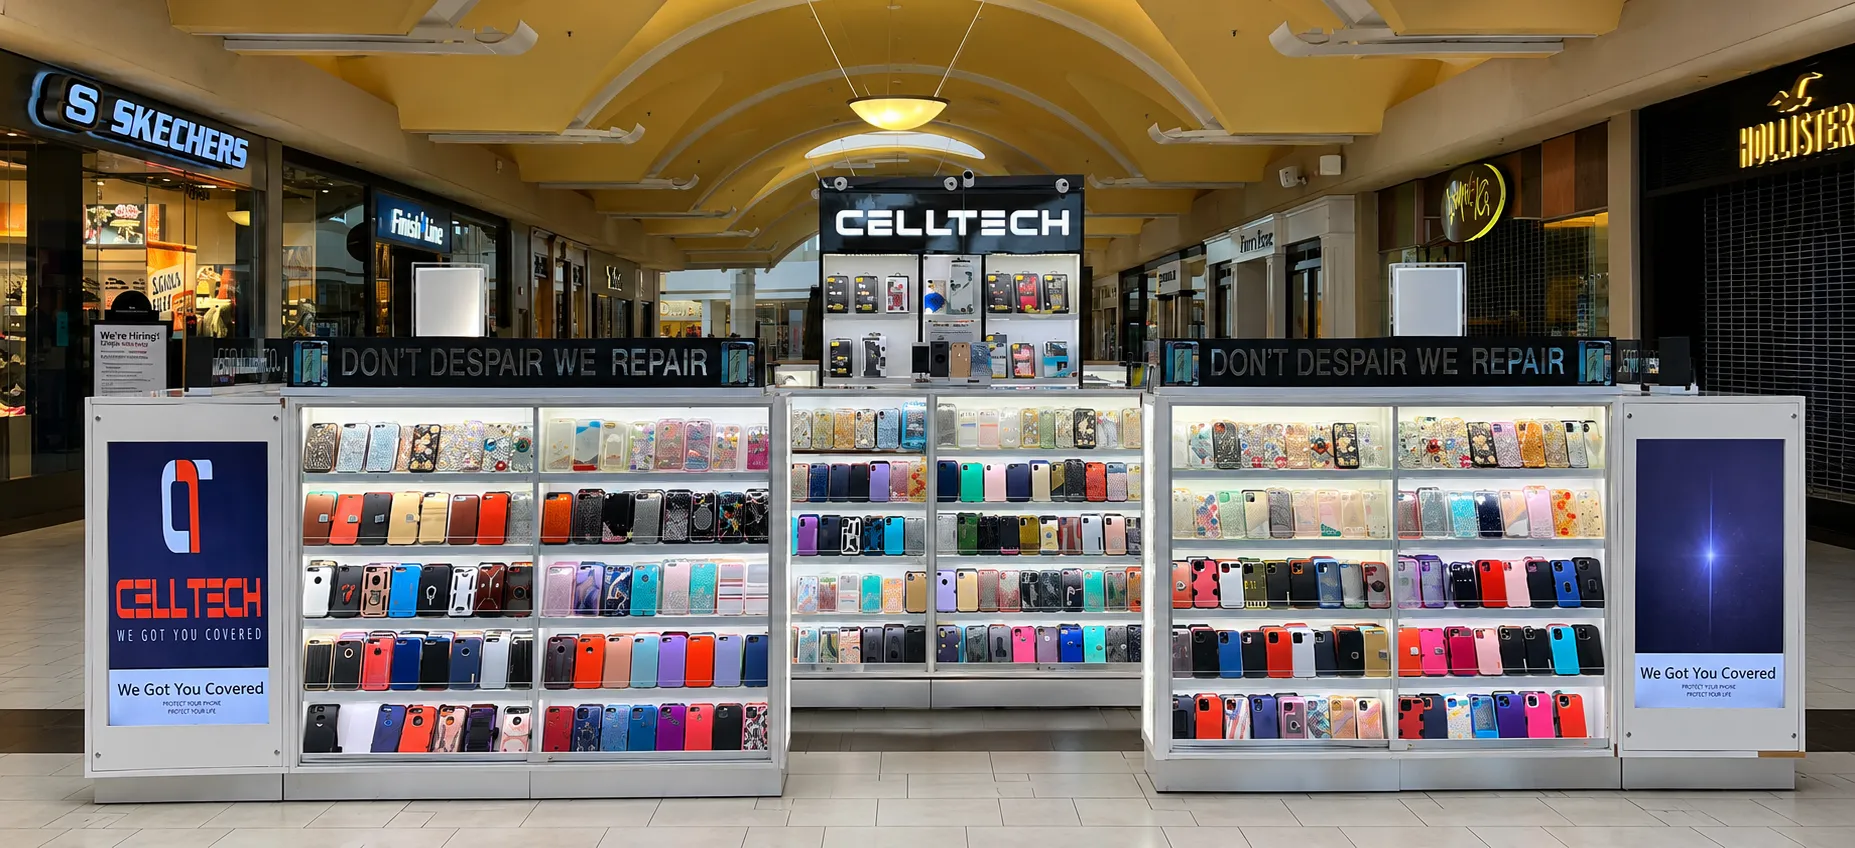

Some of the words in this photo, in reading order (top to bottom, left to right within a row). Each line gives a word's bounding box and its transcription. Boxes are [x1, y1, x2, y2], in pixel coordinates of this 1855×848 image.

[110, 98, 249, 170] SKECHERS
[1739, 102, 1855, 168] HOLLISTER
[391, 208, 421, 240] Finish
[424, 216, 444, 246] Line
[835, 209, 1070, 236] CELLTECH
[341, 347, 422, 377] DON'T
[430, 347, 543, 377] DESPAIR
[553, 347, 596, 377] WE
[611, 347, 708, 377] REPAIR
[1210, 347, 1289, 376] DON'T
[1298, 347, 1408, 376] DESPAIR
[1416, 347, 1459, 376] WE
[1472, 347, 1565, 376] REPAIR
[115, 577, 262, 619] CELLTECH
[116, 628, 133, 642] WE
[141, 628, 165, 642] GOT
[173, 628, 198, 641] YOU
[205, 627, 262, 641] COVERED
[1640, 666, 1661, 680] We
[1665, 666, 1689, 680] Got
[1692, 666, 1718, 680] You
[1721, 666, 1776, 680] Covered
[117, 683, 140, 696] We
[144, 682, 170, 696] Got
[174, 682, 201, 696] You
[205, 681, 264, 696] Covered
